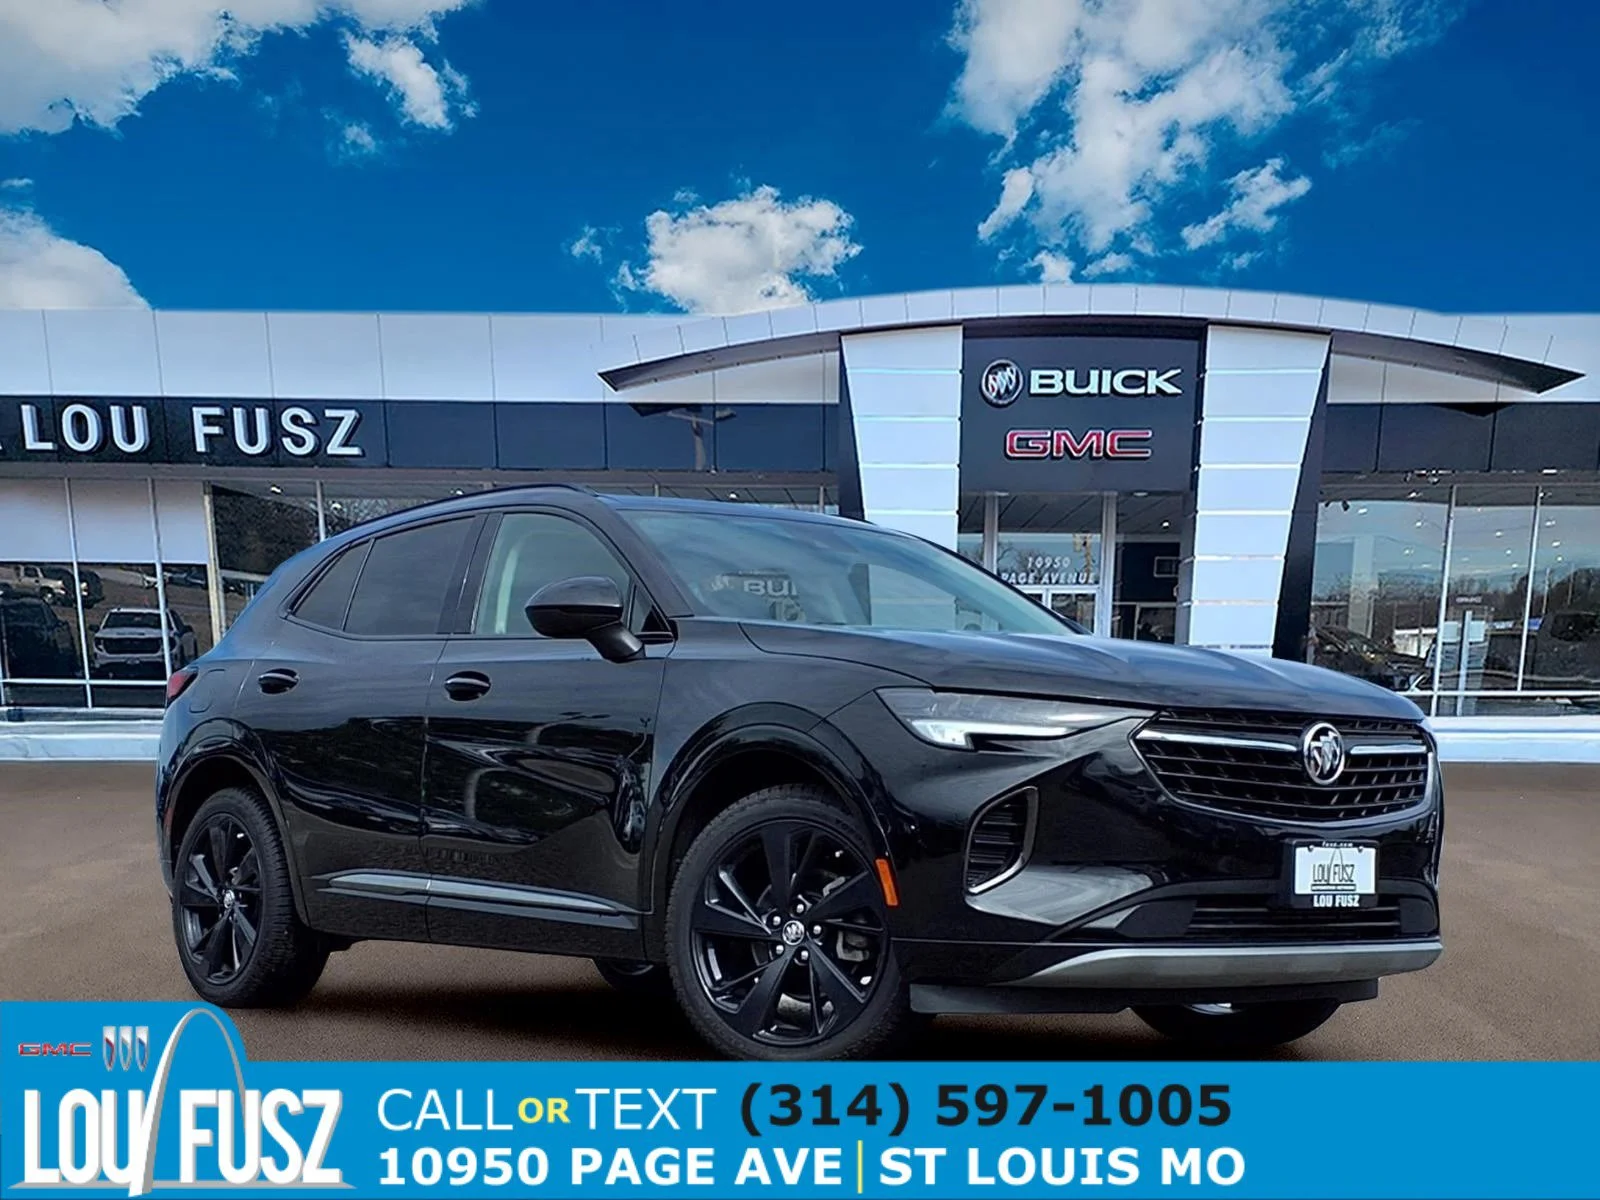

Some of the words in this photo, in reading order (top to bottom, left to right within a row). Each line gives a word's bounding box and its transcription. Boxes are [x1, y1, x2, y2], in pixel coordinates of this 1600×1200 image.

[1030, 368, 1183, 394] BUICK
[20, 403, 149, 452] LOU
[191, 406, 363, 456] FUSZ
[1006, 429, 1152, 458] GMC
[1028, 556, 1071, 569] 10950
[1001, 572, 1036, 584] PAGE
[1041, 572, 1095, 584] AVENUE
[1313, 895, 1333, 907] LOU
[1335, 895, 1360, 907] FUSZ
